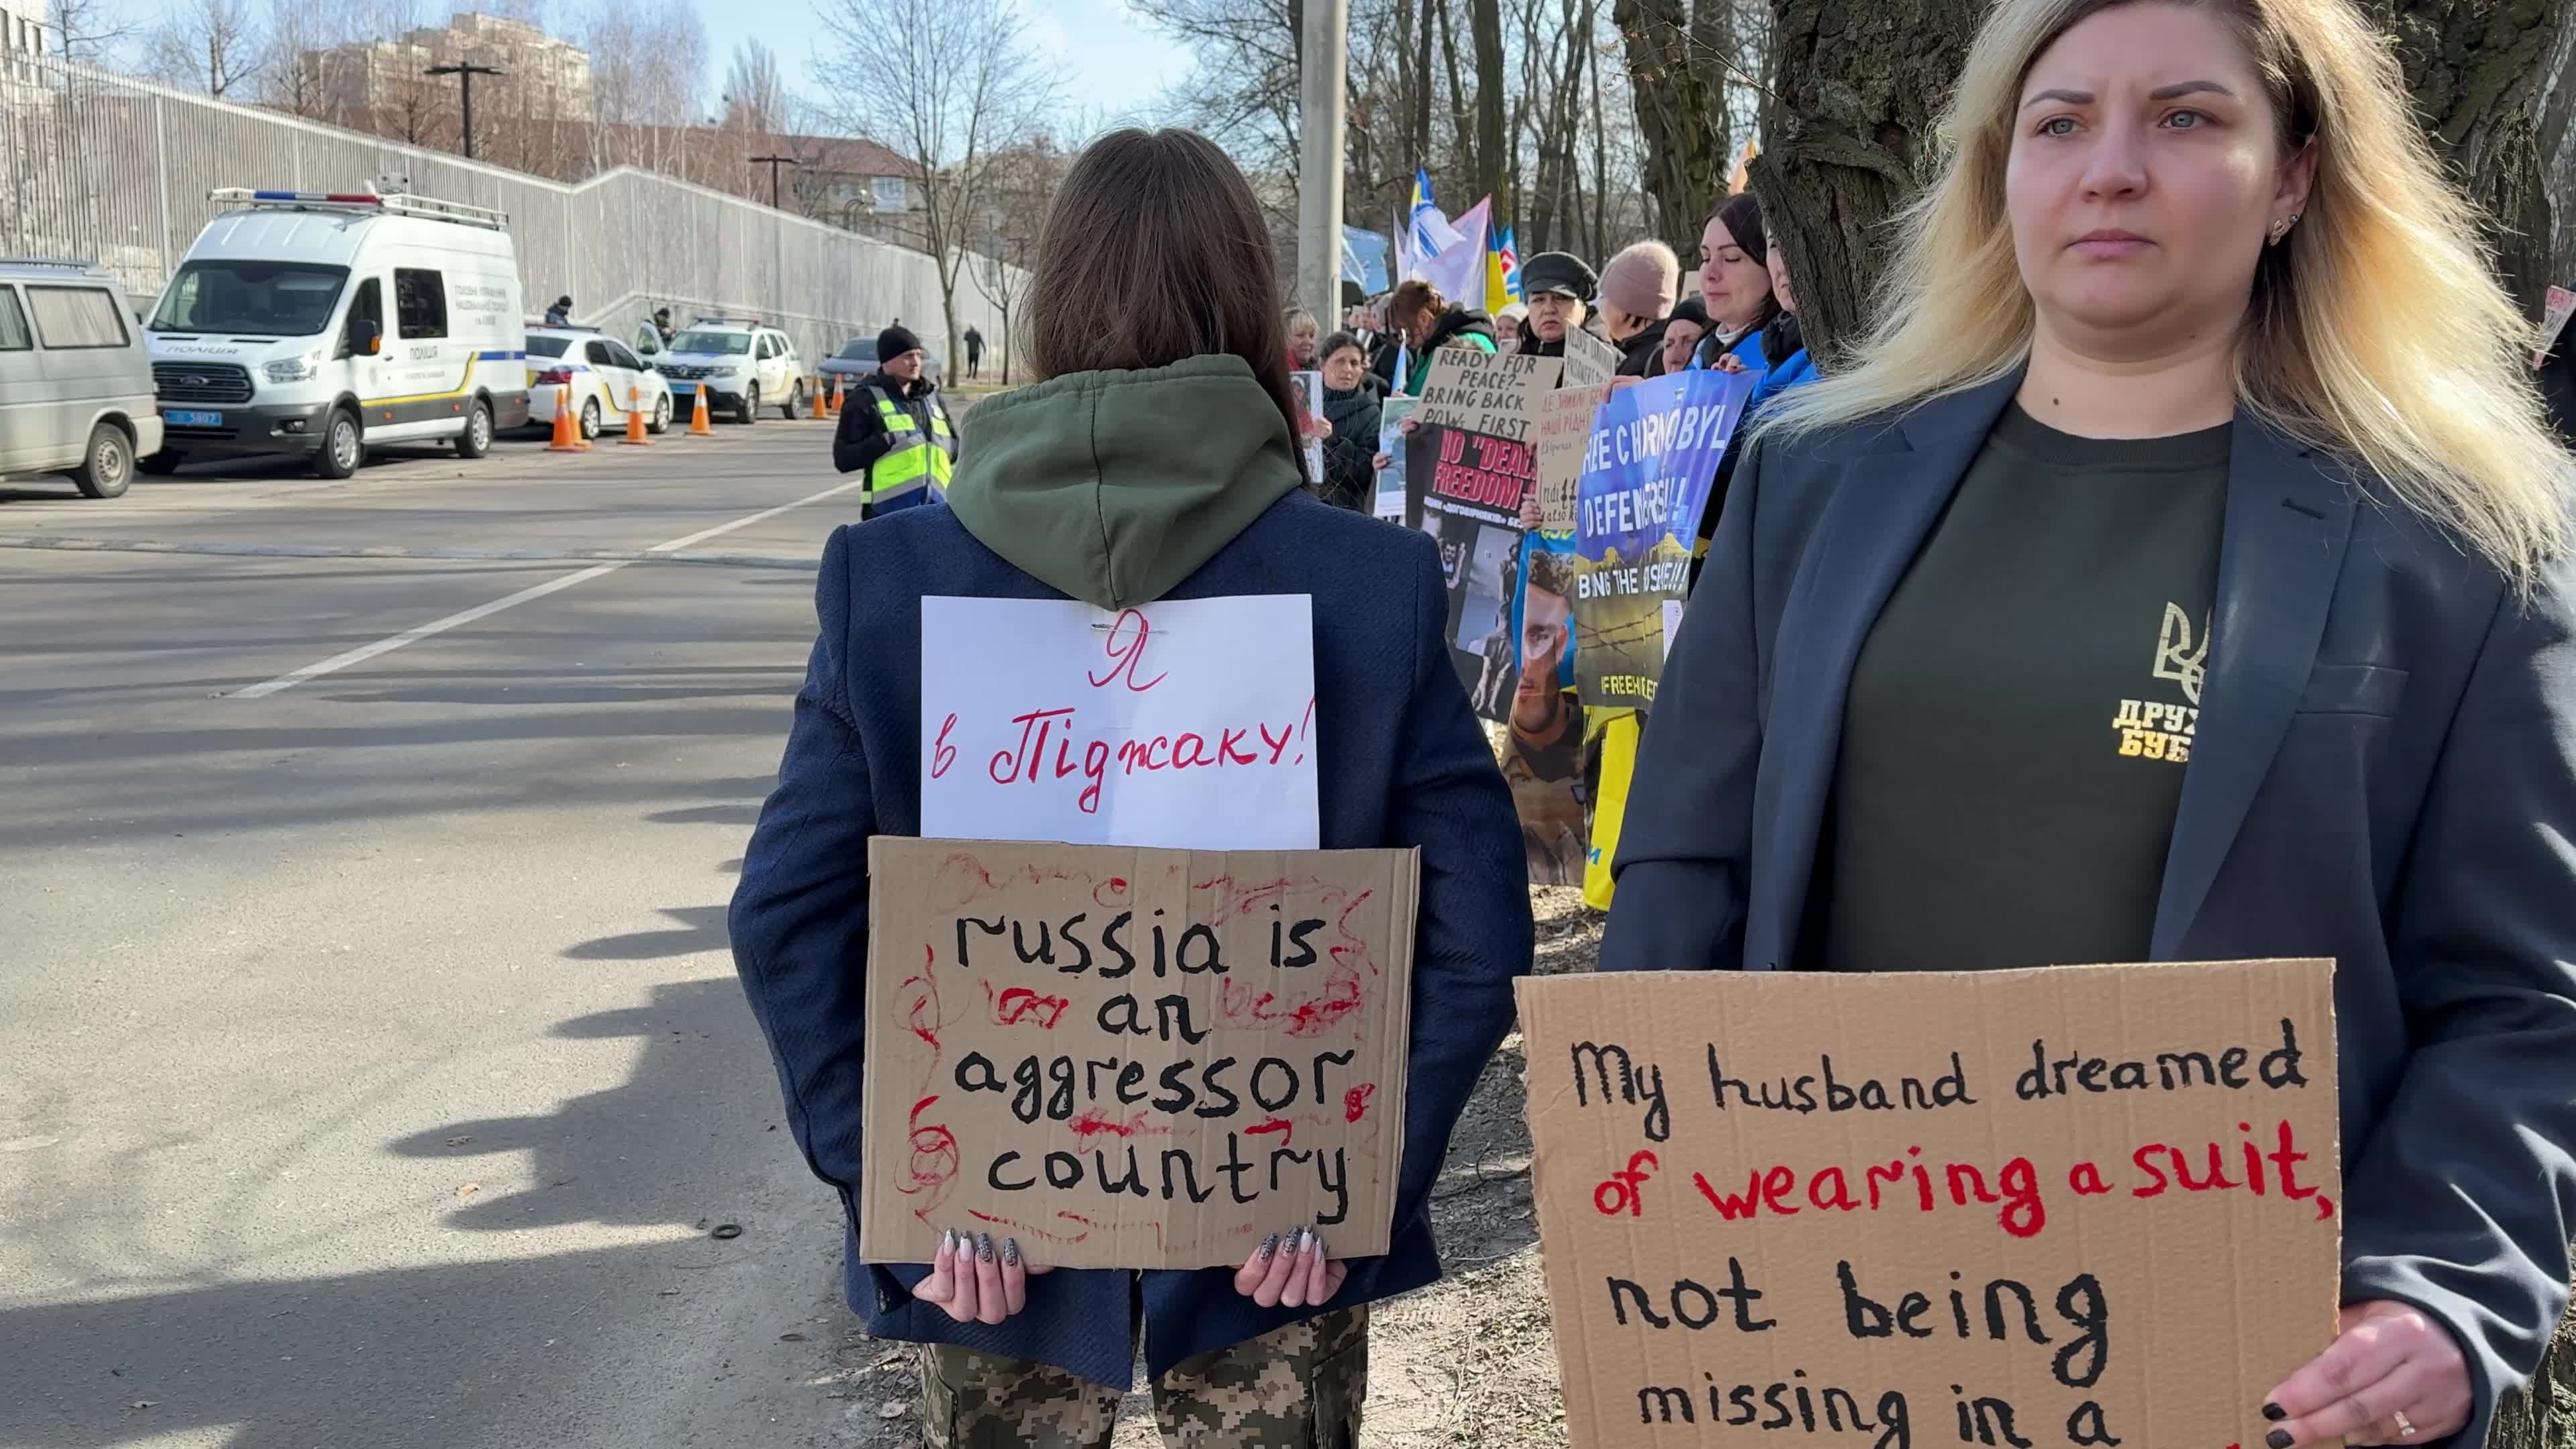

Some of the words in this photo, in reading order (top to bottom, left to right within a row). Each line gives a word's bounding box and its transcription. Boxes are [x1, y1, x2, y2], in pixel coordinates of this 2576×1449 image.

[1422, 386, 1478, 409] BRING
[1481, 392, 1525, 411] BACK
[1438, 349, 1497, 369] READY
[1503, 356, 1537, 374] FOR
[1439, 429, 1466, 464] NO
[1478, 413, 1532, 442] FIRST
[1432, 460, 1524, 511] FREEDOM
[1087, 608, 1169, 692] Я
[989, 696, 1316, 814] Піджаку!
[956, 908, 1230, 979] russia
[1269, 904, 1327, 968] is
[1097, 993, 1210, 1046] an
[954, 1048, 1356, 1125] aggressor
[1571, 1040, 1670, 1142] My
[1707, 1042, 1978, 1114] husband
[2015, 1016, 2309, 1100] dreamed
[987, 1131, 1350, 1226] country
[1593, 1149, 1660, 1218] of
[1692, 1144, 2046, 1238] wearing
[2069, 1161, 2115, 1196] a
[2132, 1119, 2334, 1222] suit,
[1607, 1256, 1777, 1333] not
[1836, 1260, 2108, 1388] being
[1638, 1368, 1911, 1449] missing
[1950, 1384, 2033, 1448] in
[2065, 1400, 2122, 1447] a
